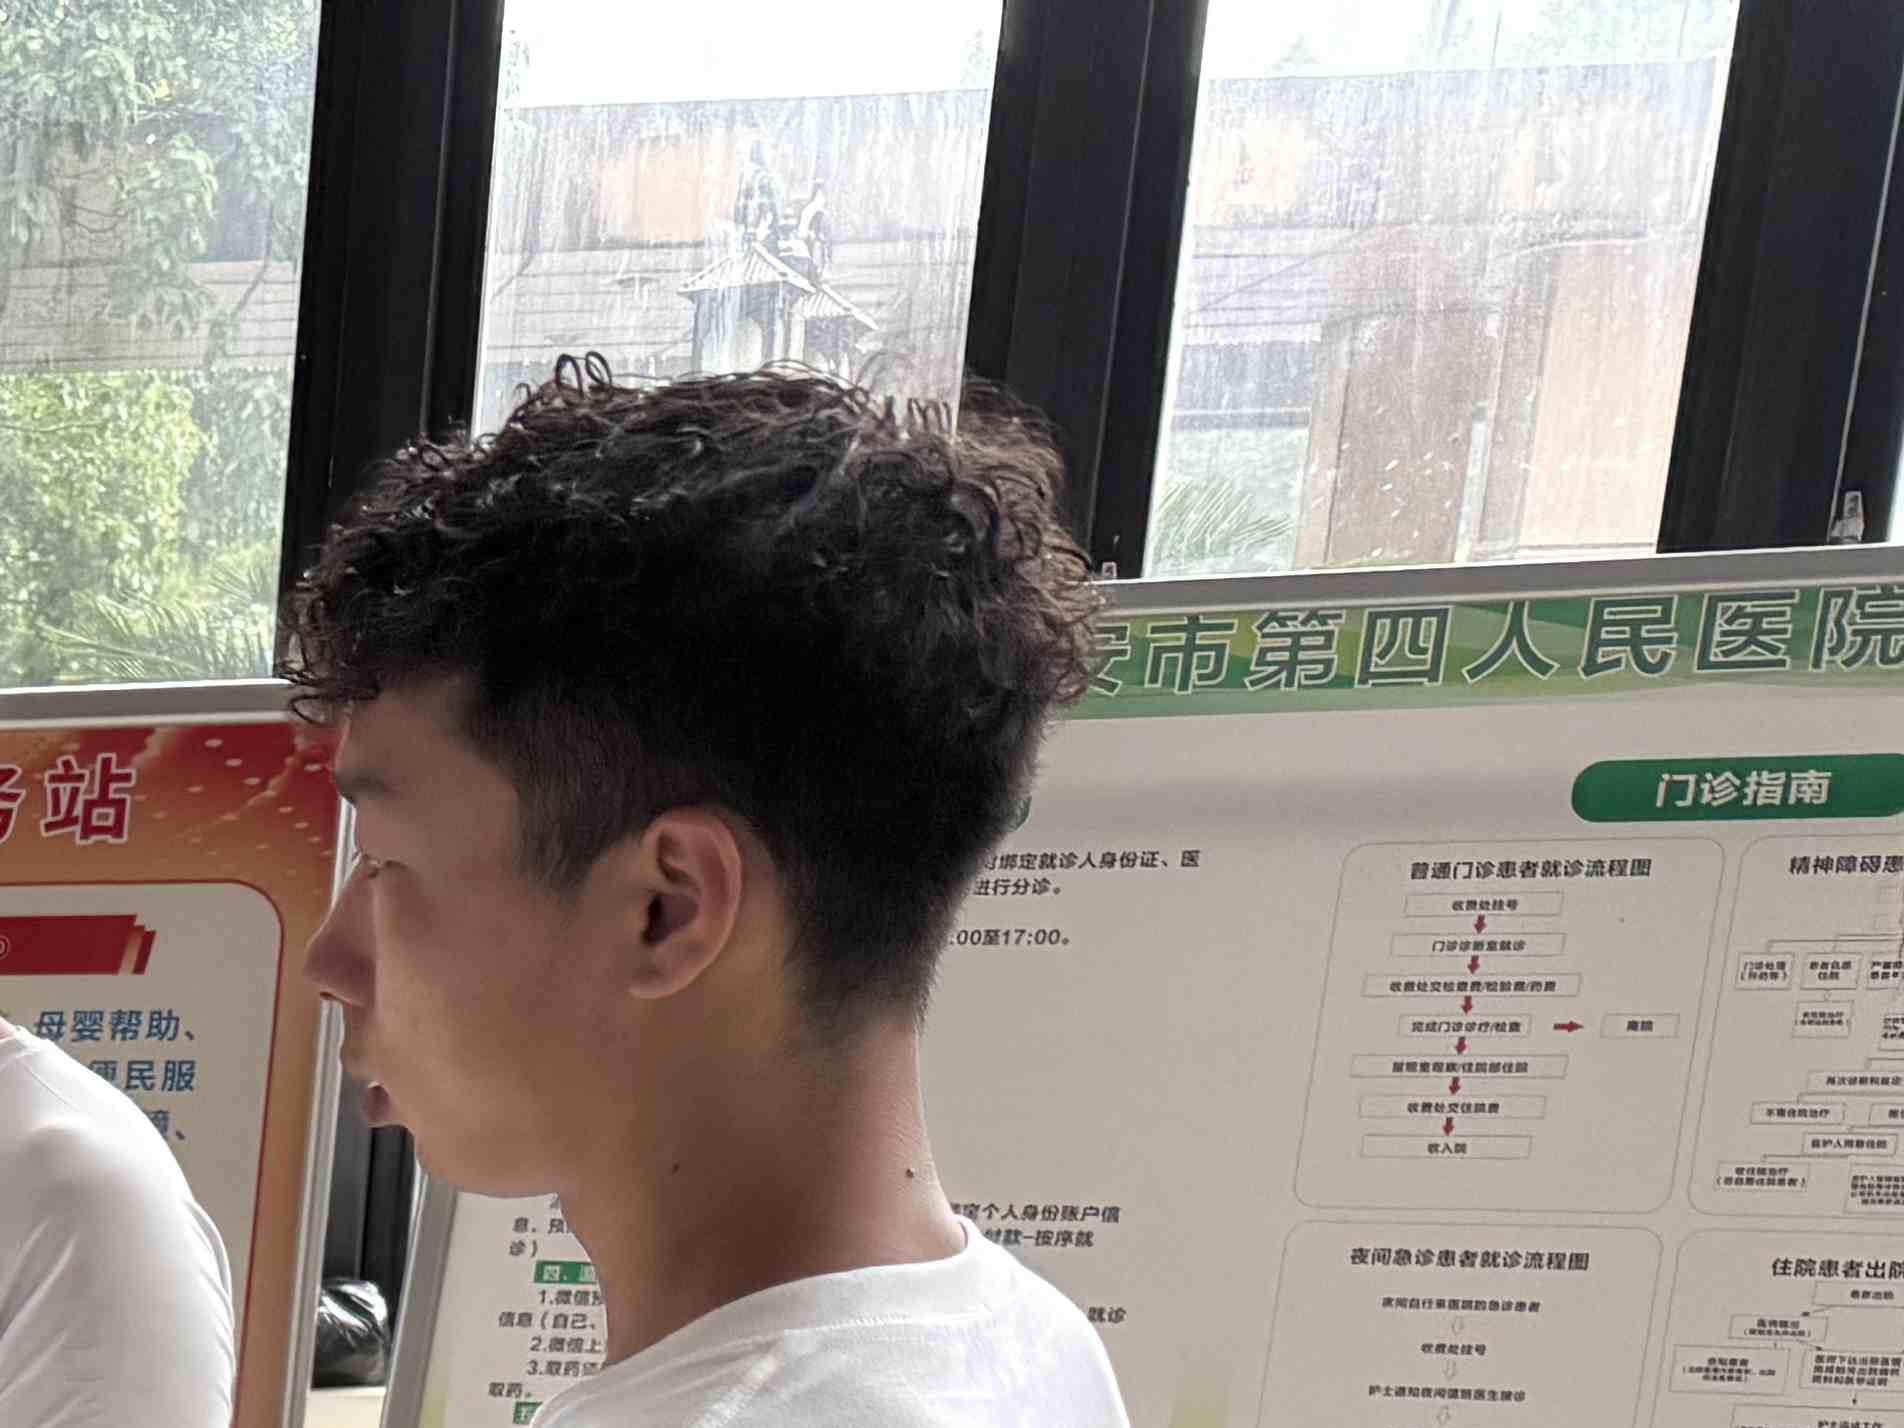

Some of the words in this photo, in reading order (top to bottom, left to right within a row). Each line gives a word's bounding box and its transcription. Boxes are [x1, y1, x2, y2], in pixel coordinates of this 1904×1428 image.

[1656, 769, 1832, 808] 门诊指南
[1410, 858, 1653, 881] 普通门诊患者就诊流程图
[1350, 1248, 1590, 1271] 夜间急诊患者就诊流程图
